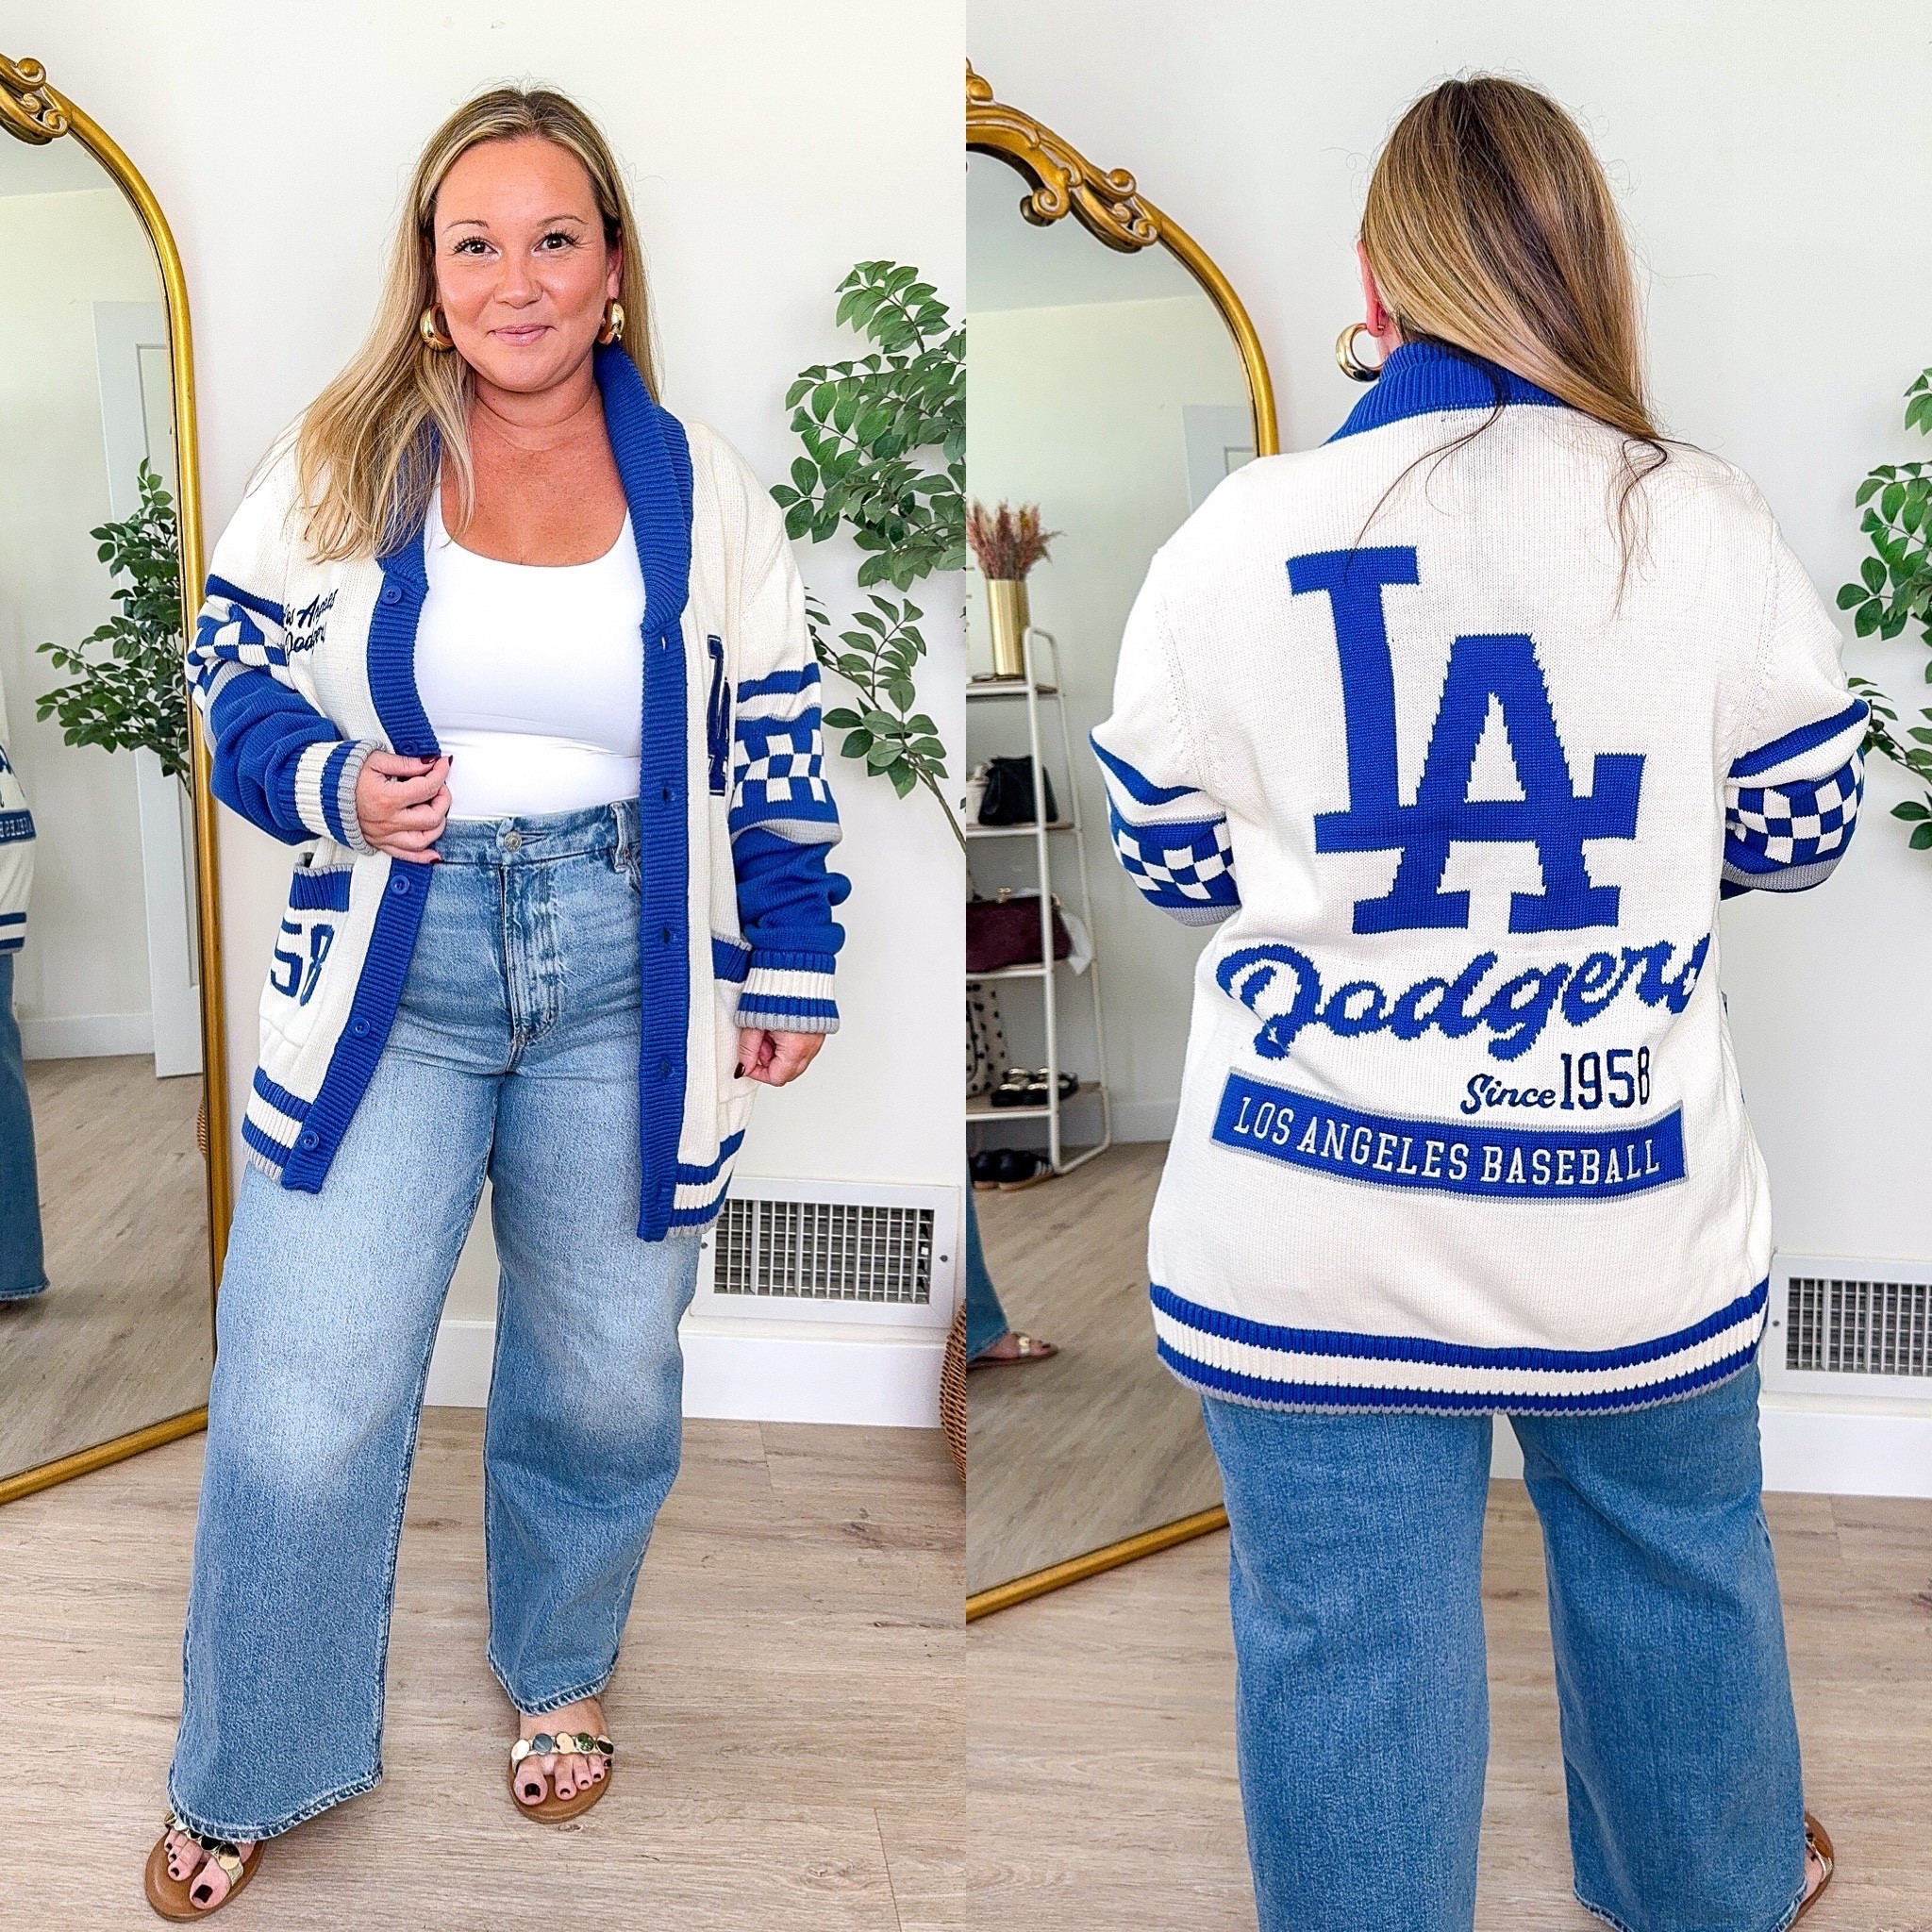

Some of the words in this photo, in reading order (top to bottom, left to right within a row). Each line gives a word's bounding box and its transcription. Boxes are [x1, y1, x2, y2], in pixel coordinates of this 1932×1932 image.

[1286, 545, 1646, 934] LA
[270, 916, 335, 1008] 58
[1460, 1073, 1556, 1114] Since
[1559, 1045, 1650, 1110] 1958
[1234, 1096, 1294, 1144] LOS
[1297, 1116, 1469, 1180] ANGELES
[1480, 1139, 1660, 1185] BASEBALL
